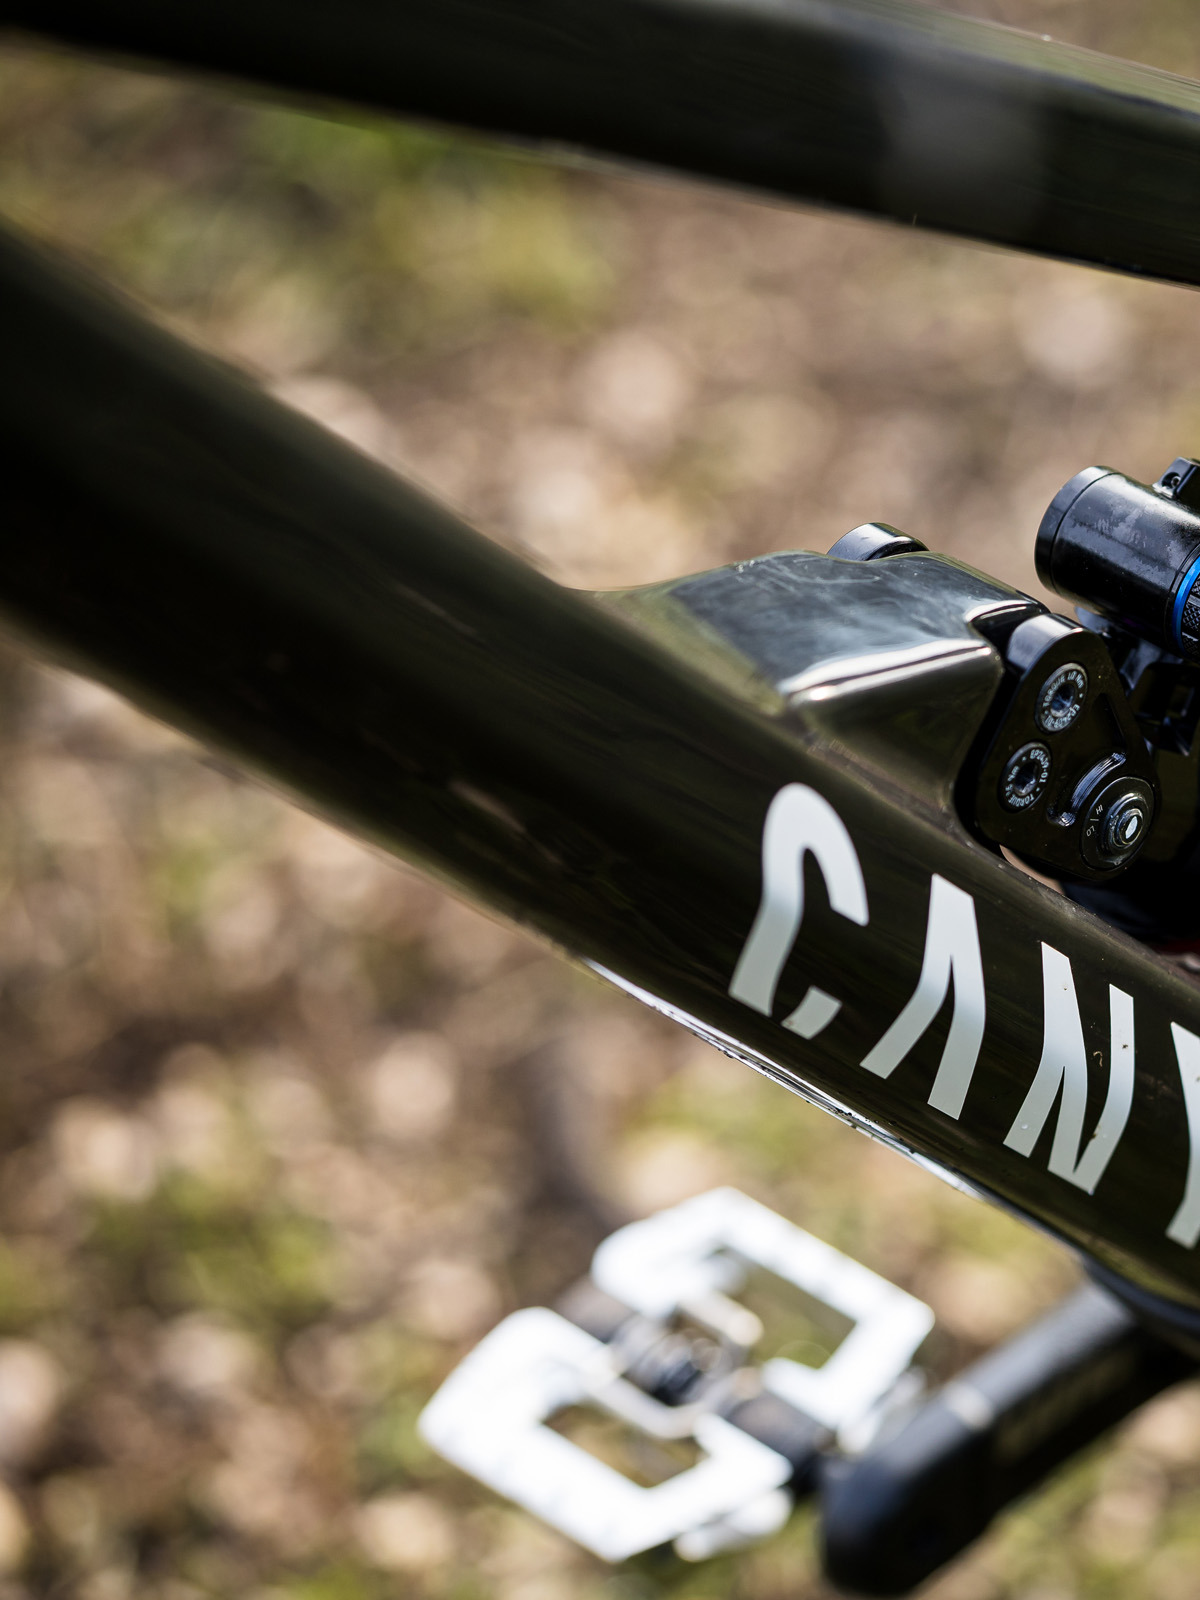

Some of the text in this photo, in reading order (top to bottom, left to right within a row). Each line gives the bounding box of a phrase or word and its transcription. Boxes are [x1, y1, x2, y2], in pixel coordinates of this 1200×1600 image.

[1042, 674, 1066, 707] TORQUE
[1008, 793, 1035, 808] TORQUE
[1095, 804, 1104, 815] HI
[1086, 825, 1095, 837] LO
